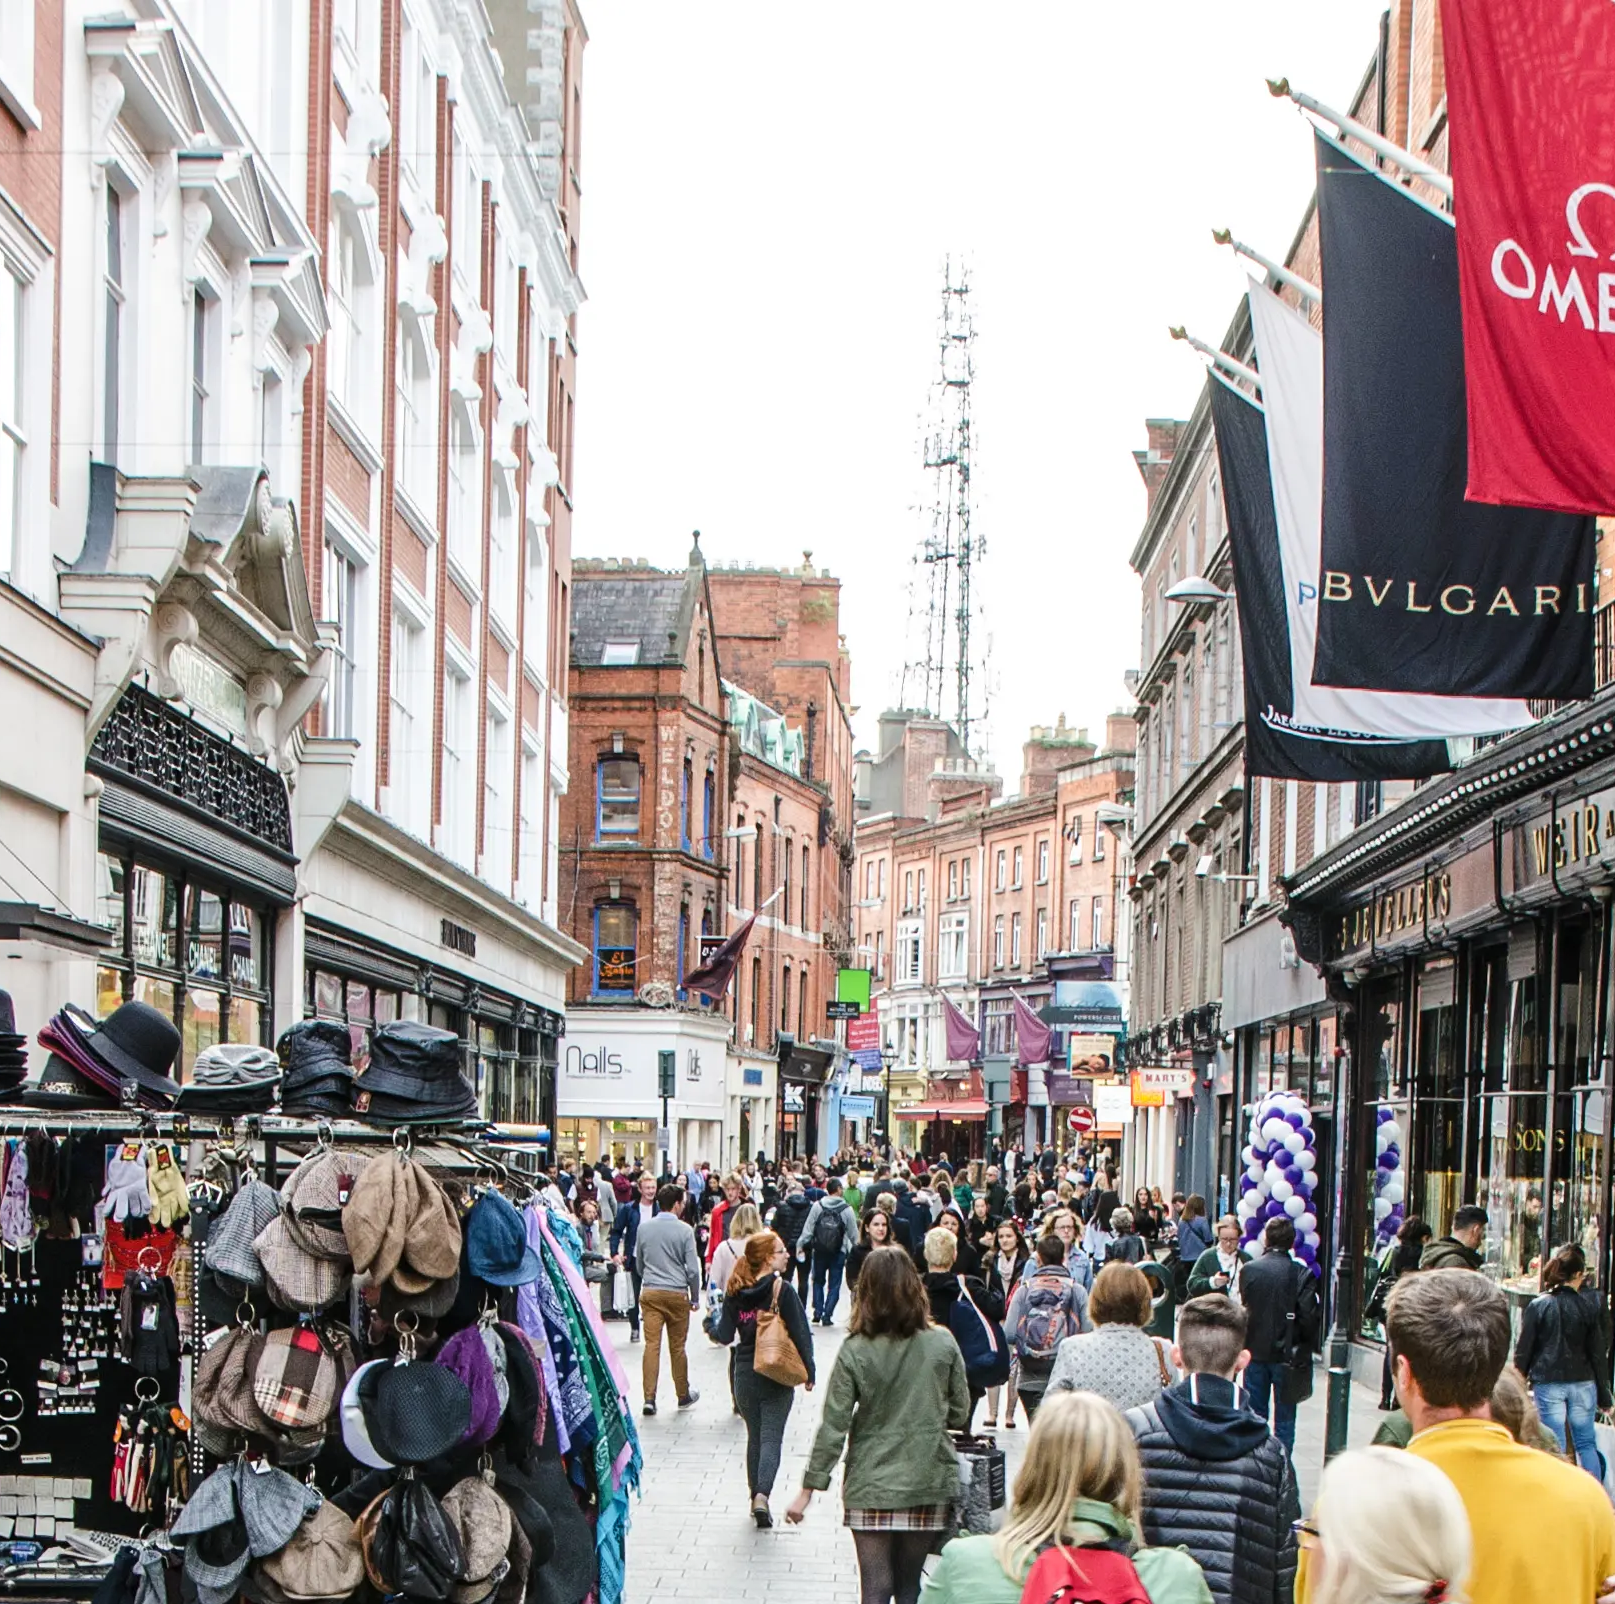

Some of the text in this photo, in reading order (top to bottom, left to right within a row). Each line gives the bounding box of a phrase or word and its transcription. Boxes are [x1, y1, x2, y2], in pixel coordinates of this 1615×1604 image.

[1322, 571, 1587, 617] BVLGARI
[1532, 804, 1602, 877] WEIR
[188, 940, 218, 974] CHANEL
[231, 953, 258, 985] CHANEL
[1144, 1073, 1188, 1084] MARY'S
